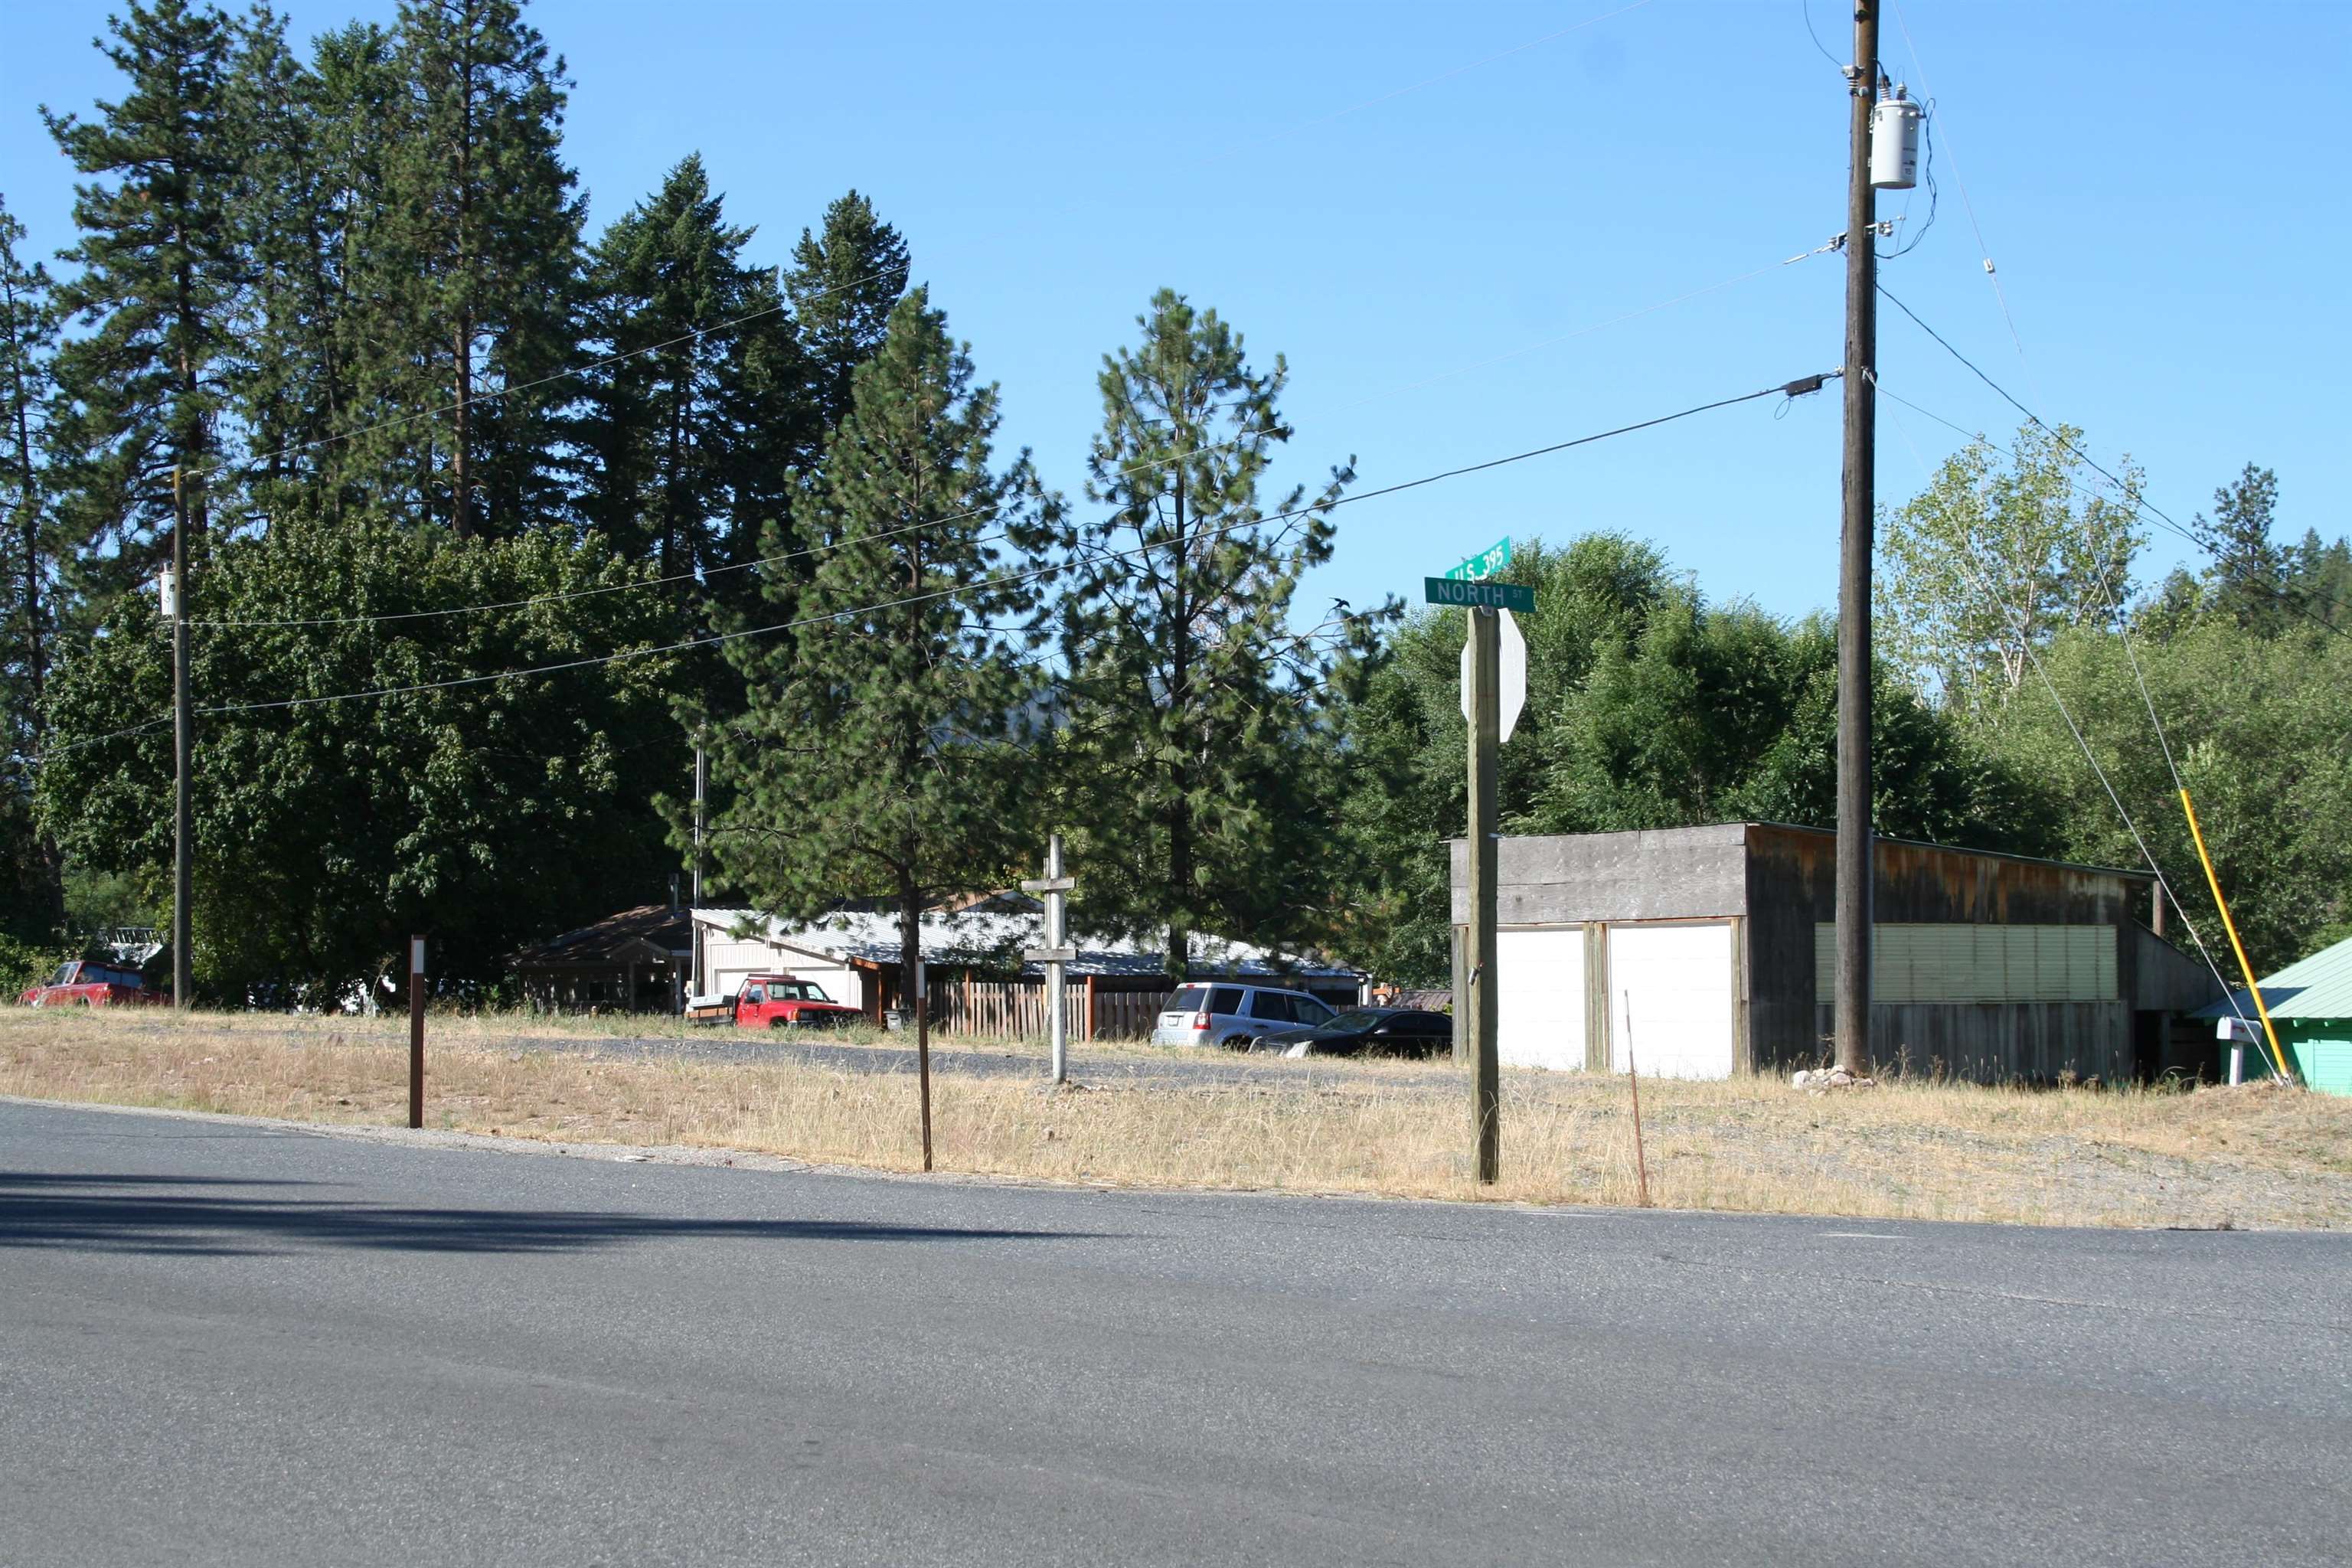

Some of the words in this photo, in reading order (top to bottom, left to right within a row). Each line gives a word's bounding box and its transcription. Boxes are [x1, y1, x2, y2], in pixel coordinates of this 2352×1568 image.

[1483, 545, 1503, 575] 395
[1438, 583, 1504, 605] NORTH
[1512, 589, 1523, 599] ST
